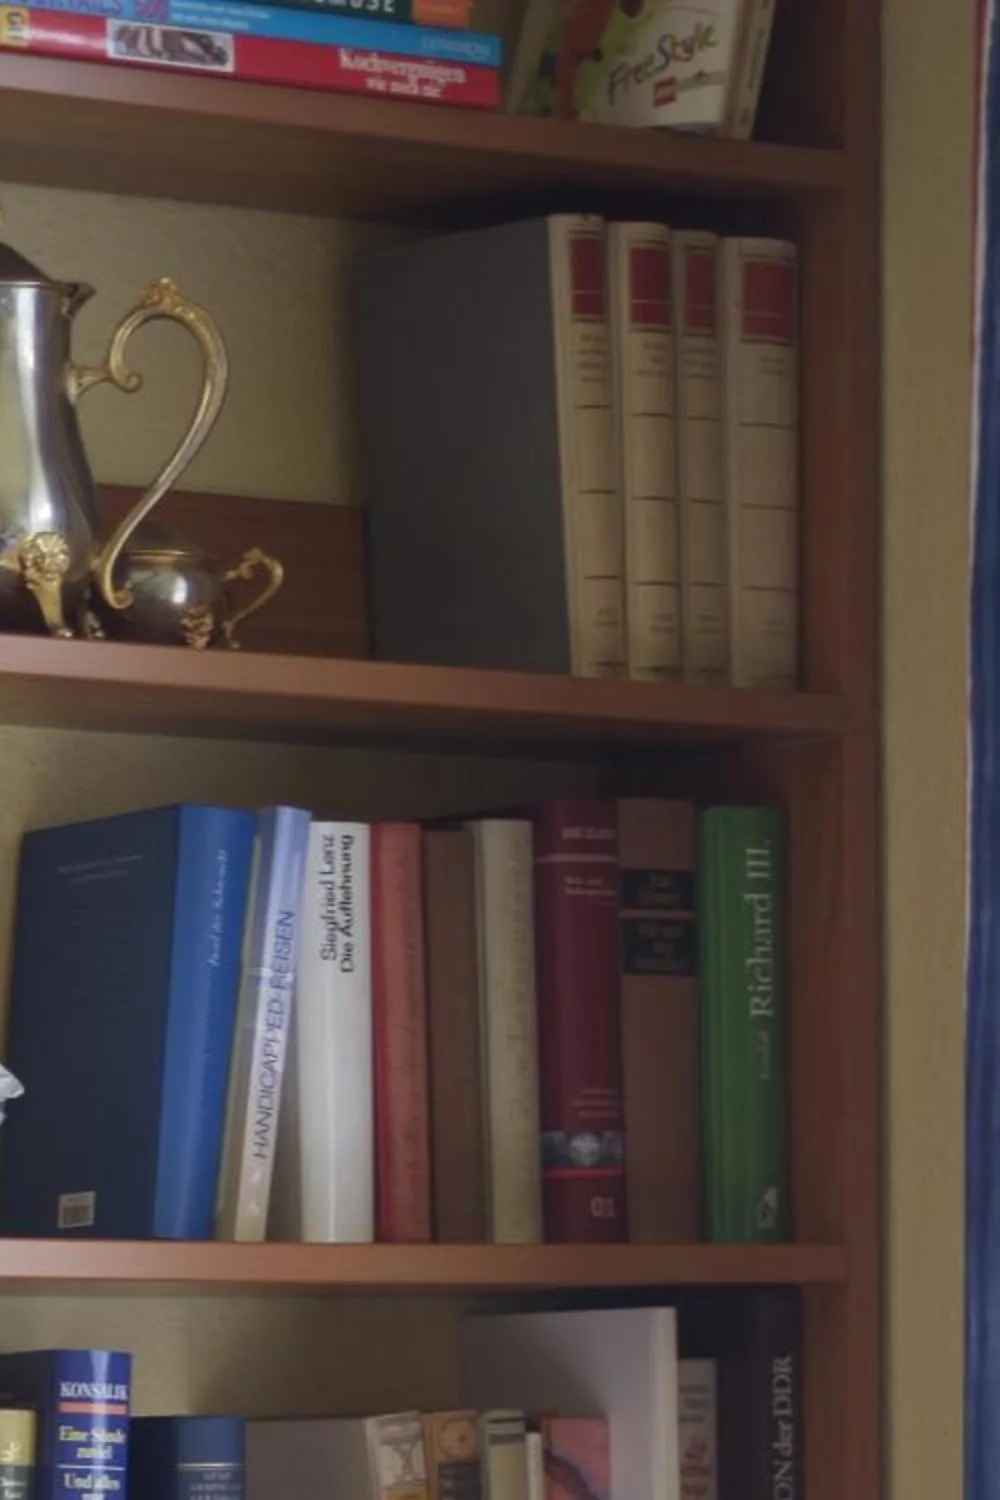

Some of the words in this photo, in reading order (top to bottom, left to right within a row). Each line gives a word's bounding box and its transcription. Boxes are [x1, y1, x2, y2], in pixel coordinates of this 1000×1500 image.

[319, 834, 335, 869] Lenz
[337, 835, 356, 938] Auflehnung
[319, 880, 339, 962] Siegfried
[339, 945, 355, 974] Die
[744, 891, 774, 1018] Richard
[59, 1379, 129, 1400] KONSALIK
[771, 1355, 792, 1416] DDR
[772, 1416, 794, 1458] der
